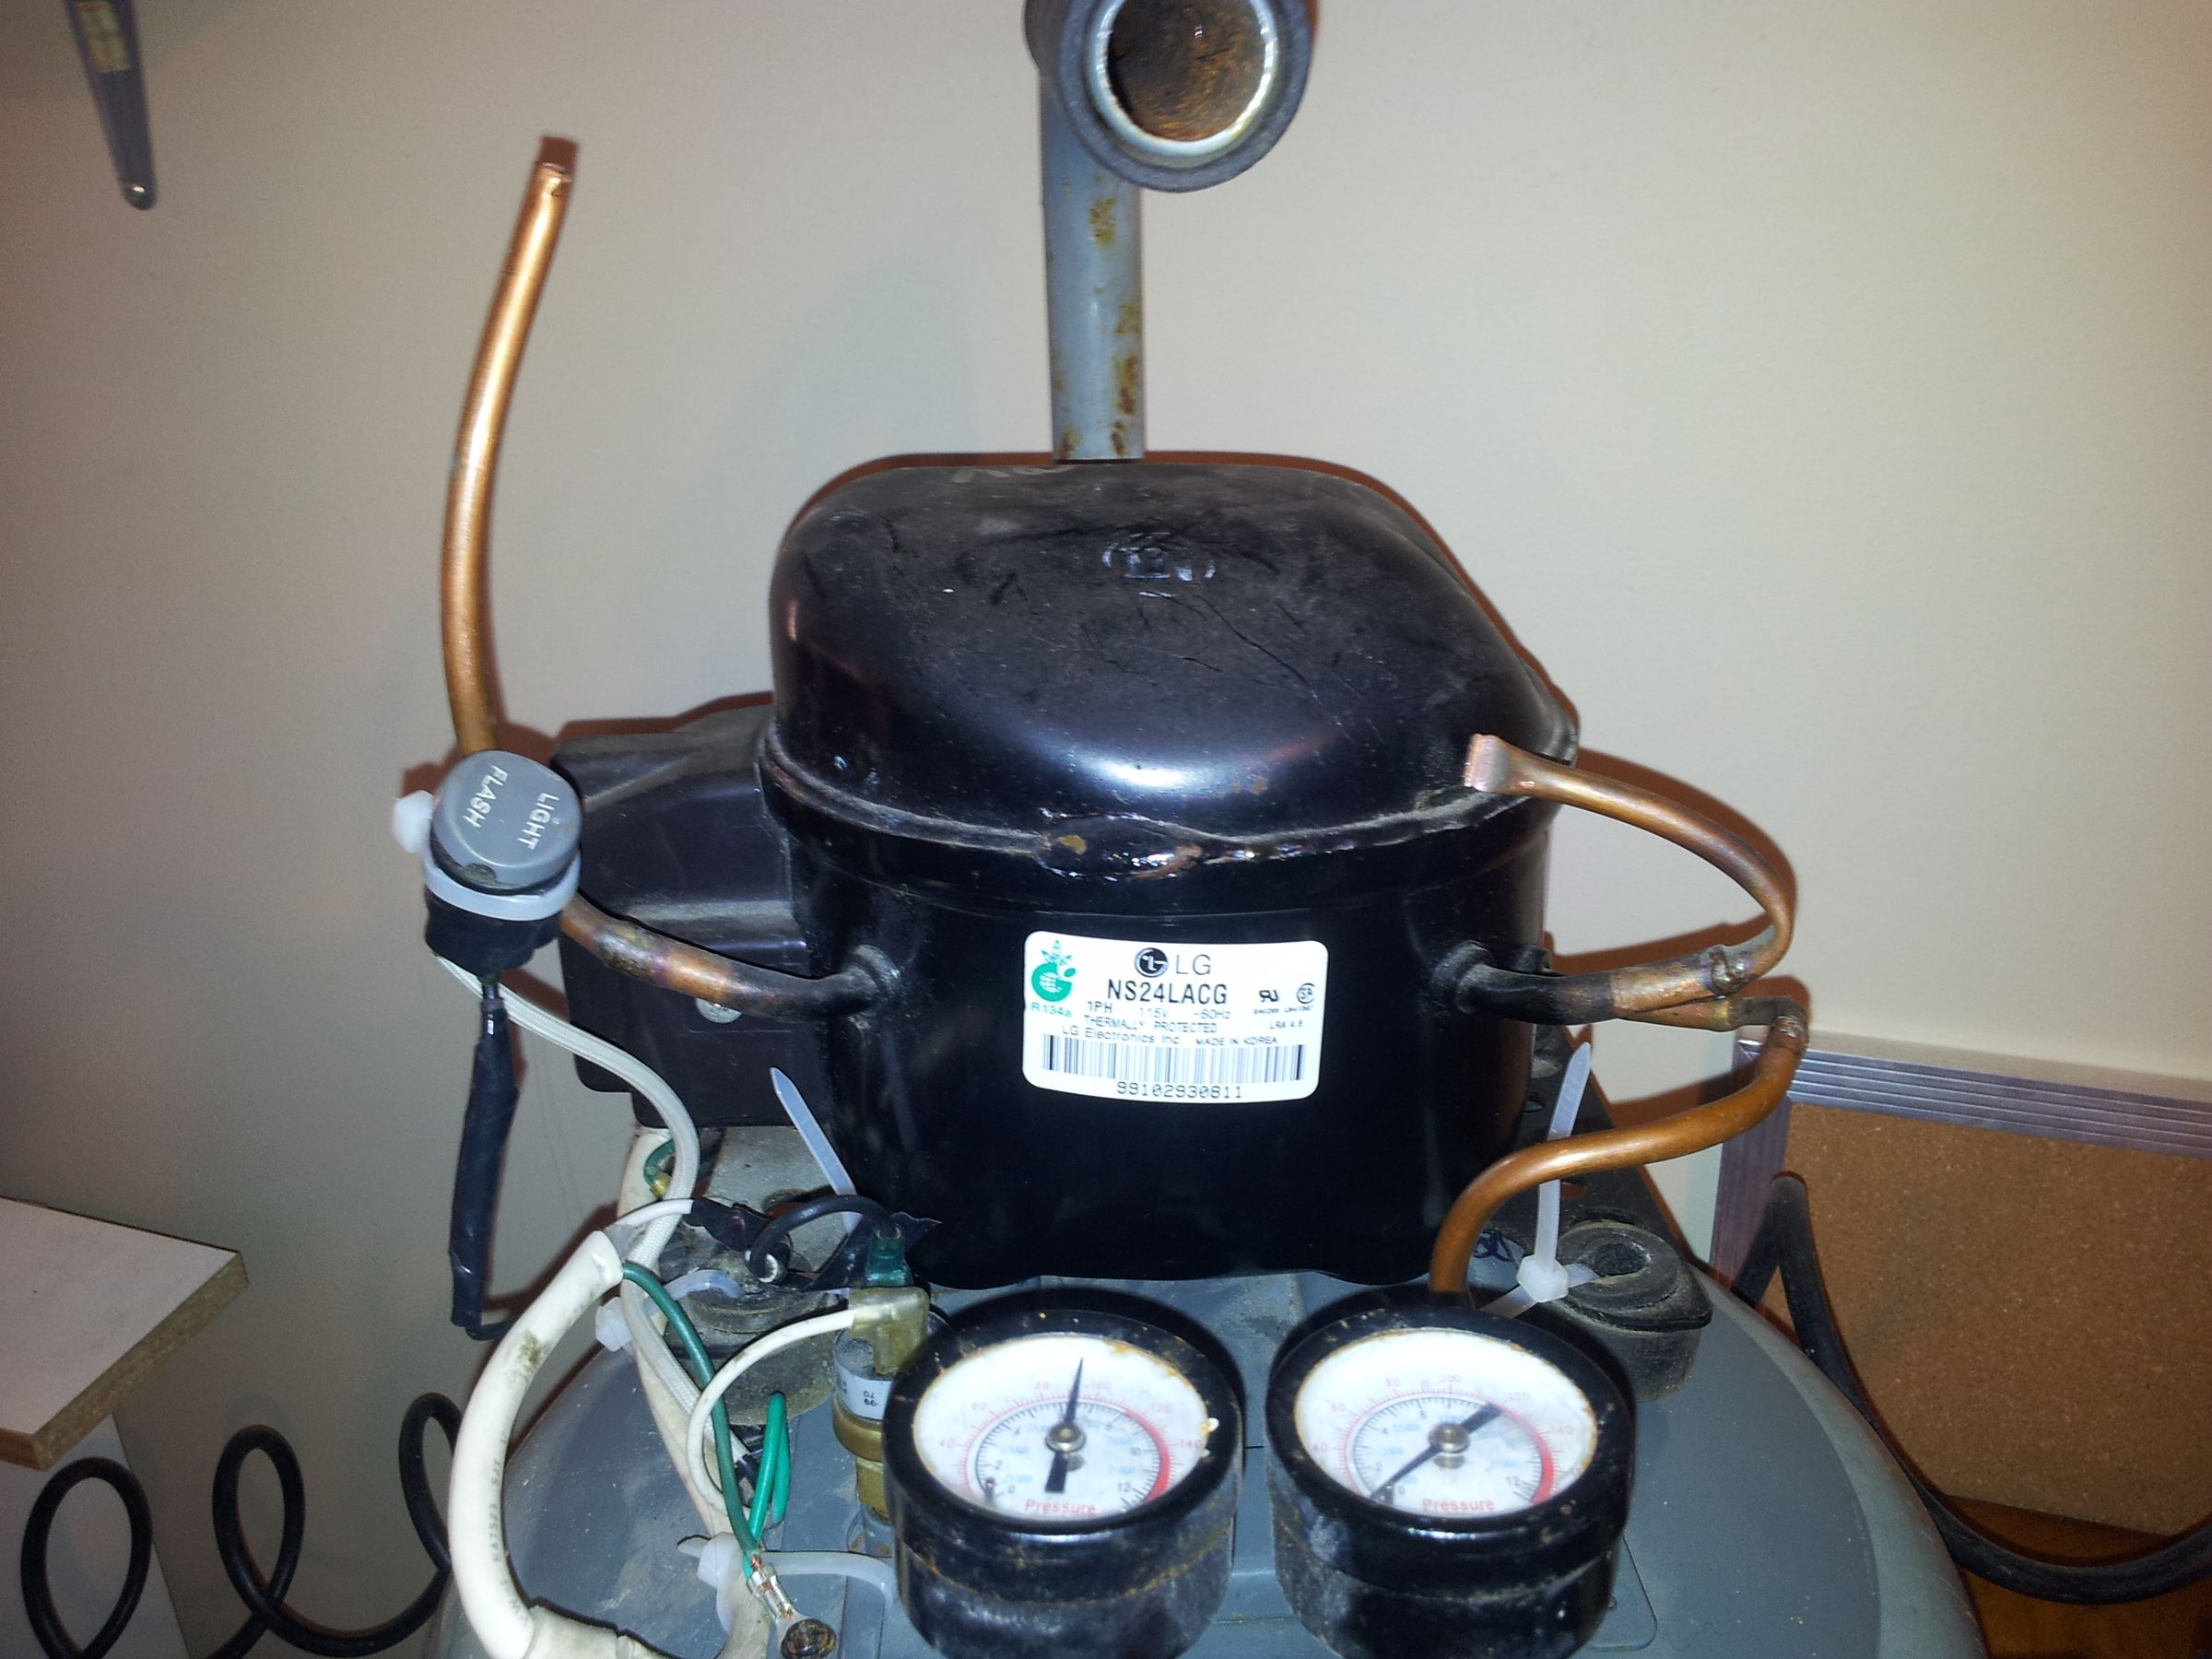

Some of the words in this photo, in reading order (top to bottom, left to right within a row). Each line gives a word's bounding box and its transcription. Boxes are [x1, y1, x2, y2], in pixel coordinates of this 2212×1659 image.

[462, 764, 509, 828] FLASH
[517, 793, 560, 851] LIGHT
[1176, 954, 1212, 976] LG
[1108, 979, 1228, 1005] NS24LACG
[1087, 1001, 1113, 1014] 1PH
[1084, 1014, 1146, 1030] THERMALLY
[1153, 1020, 1218, 1033] PROTECTED
[1062, 1024, 1079, 1036] LG
[1084, 1027, 1156, 1043] Electronics
[1195, 1037, 1226, 1046] MADE
[1230, 1037, 1240, 1045] IN
[1243, 1036, 1277, 1045] KOREA
[1117, 1482, 1132, 1493] 12
[1505, 1476, 1521, 1487] 12
[1025, 1498, 1098, 1515] Pressure
[1422, 1498, 1496, 1512] Pressure
